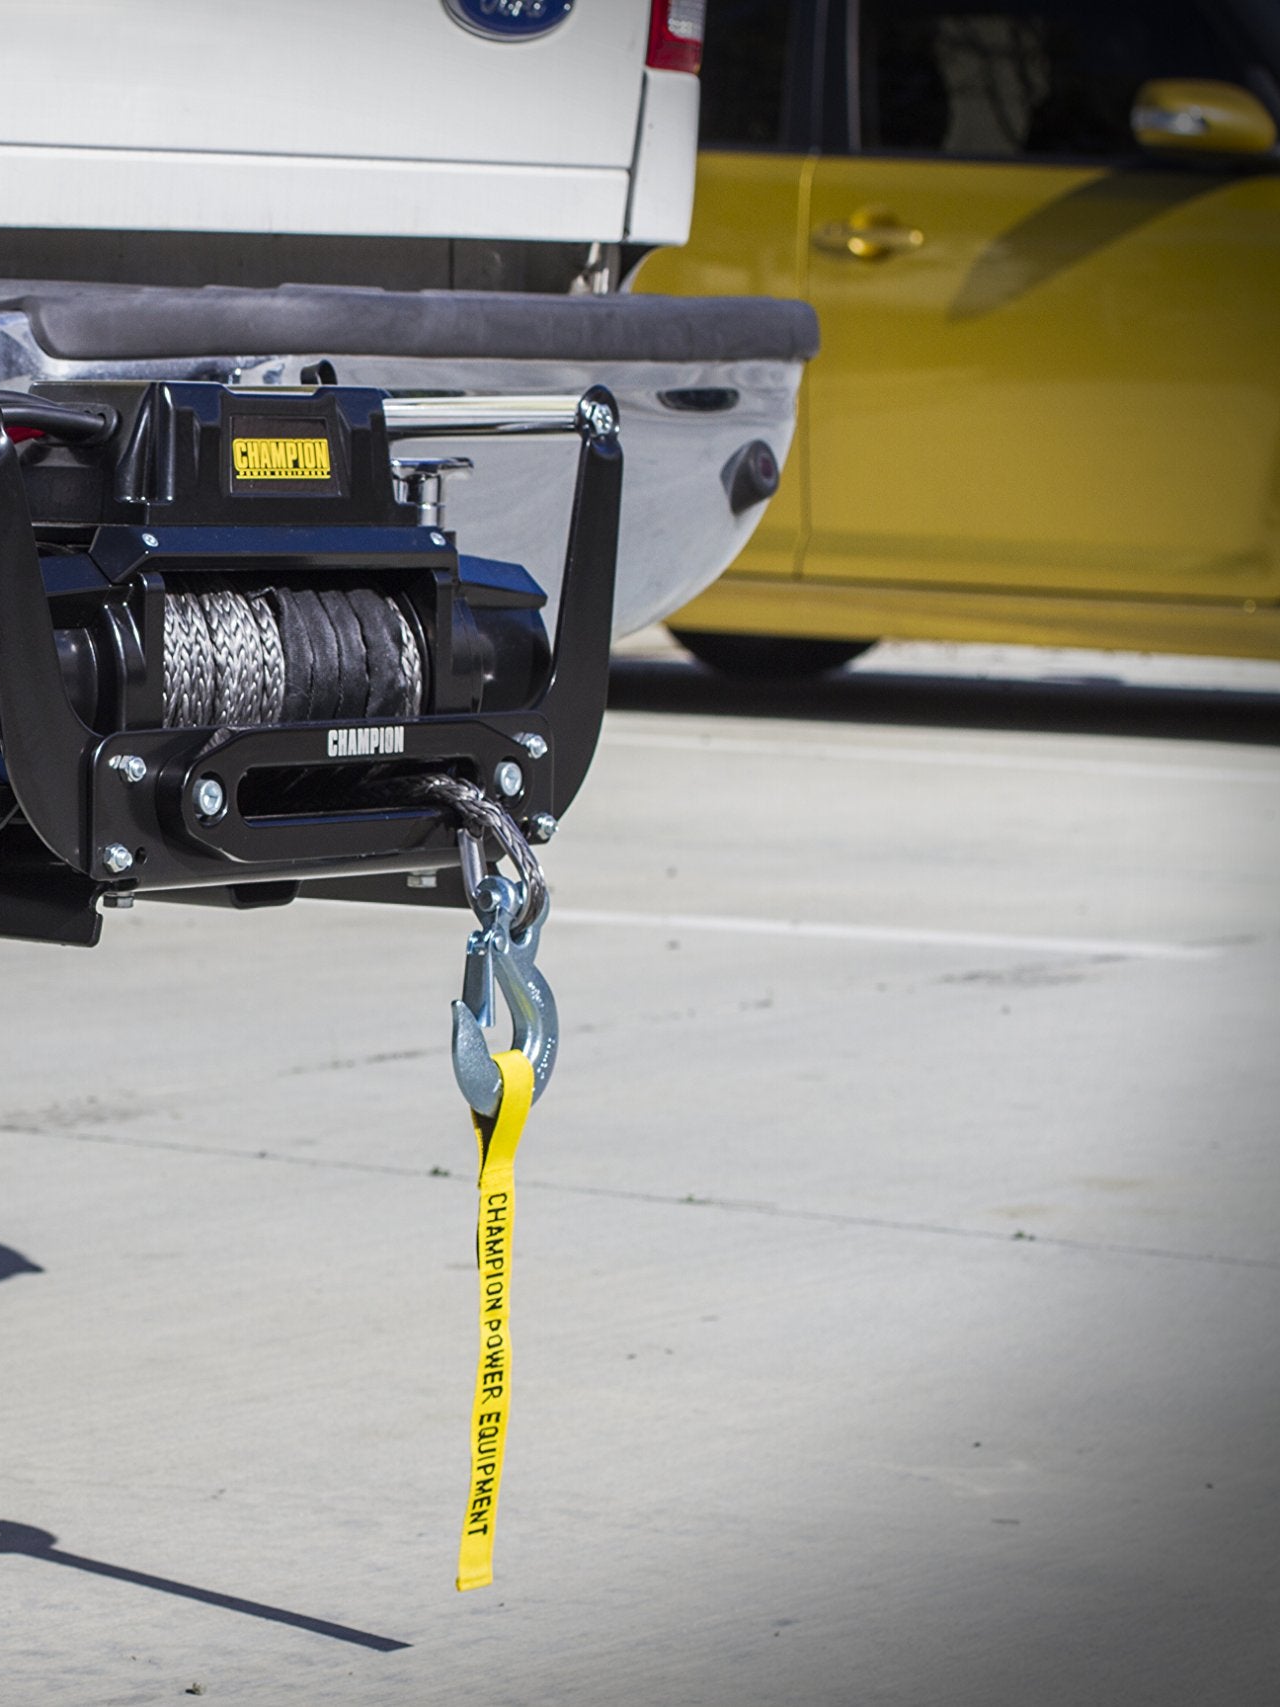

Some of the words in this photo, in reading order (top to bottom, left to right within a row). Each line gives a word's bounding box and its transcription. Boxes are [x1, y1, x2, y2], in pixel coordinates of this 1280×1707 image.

[234, 441, 329, 469] CHAMPION
[328, 726, 404, 757] CHAMPION
[485, 1192, 508, 1312] CHAMPION
[482, 1318, 504, 1405] POWER
[467, 1411, 501, 1536] EQUIPMENT
